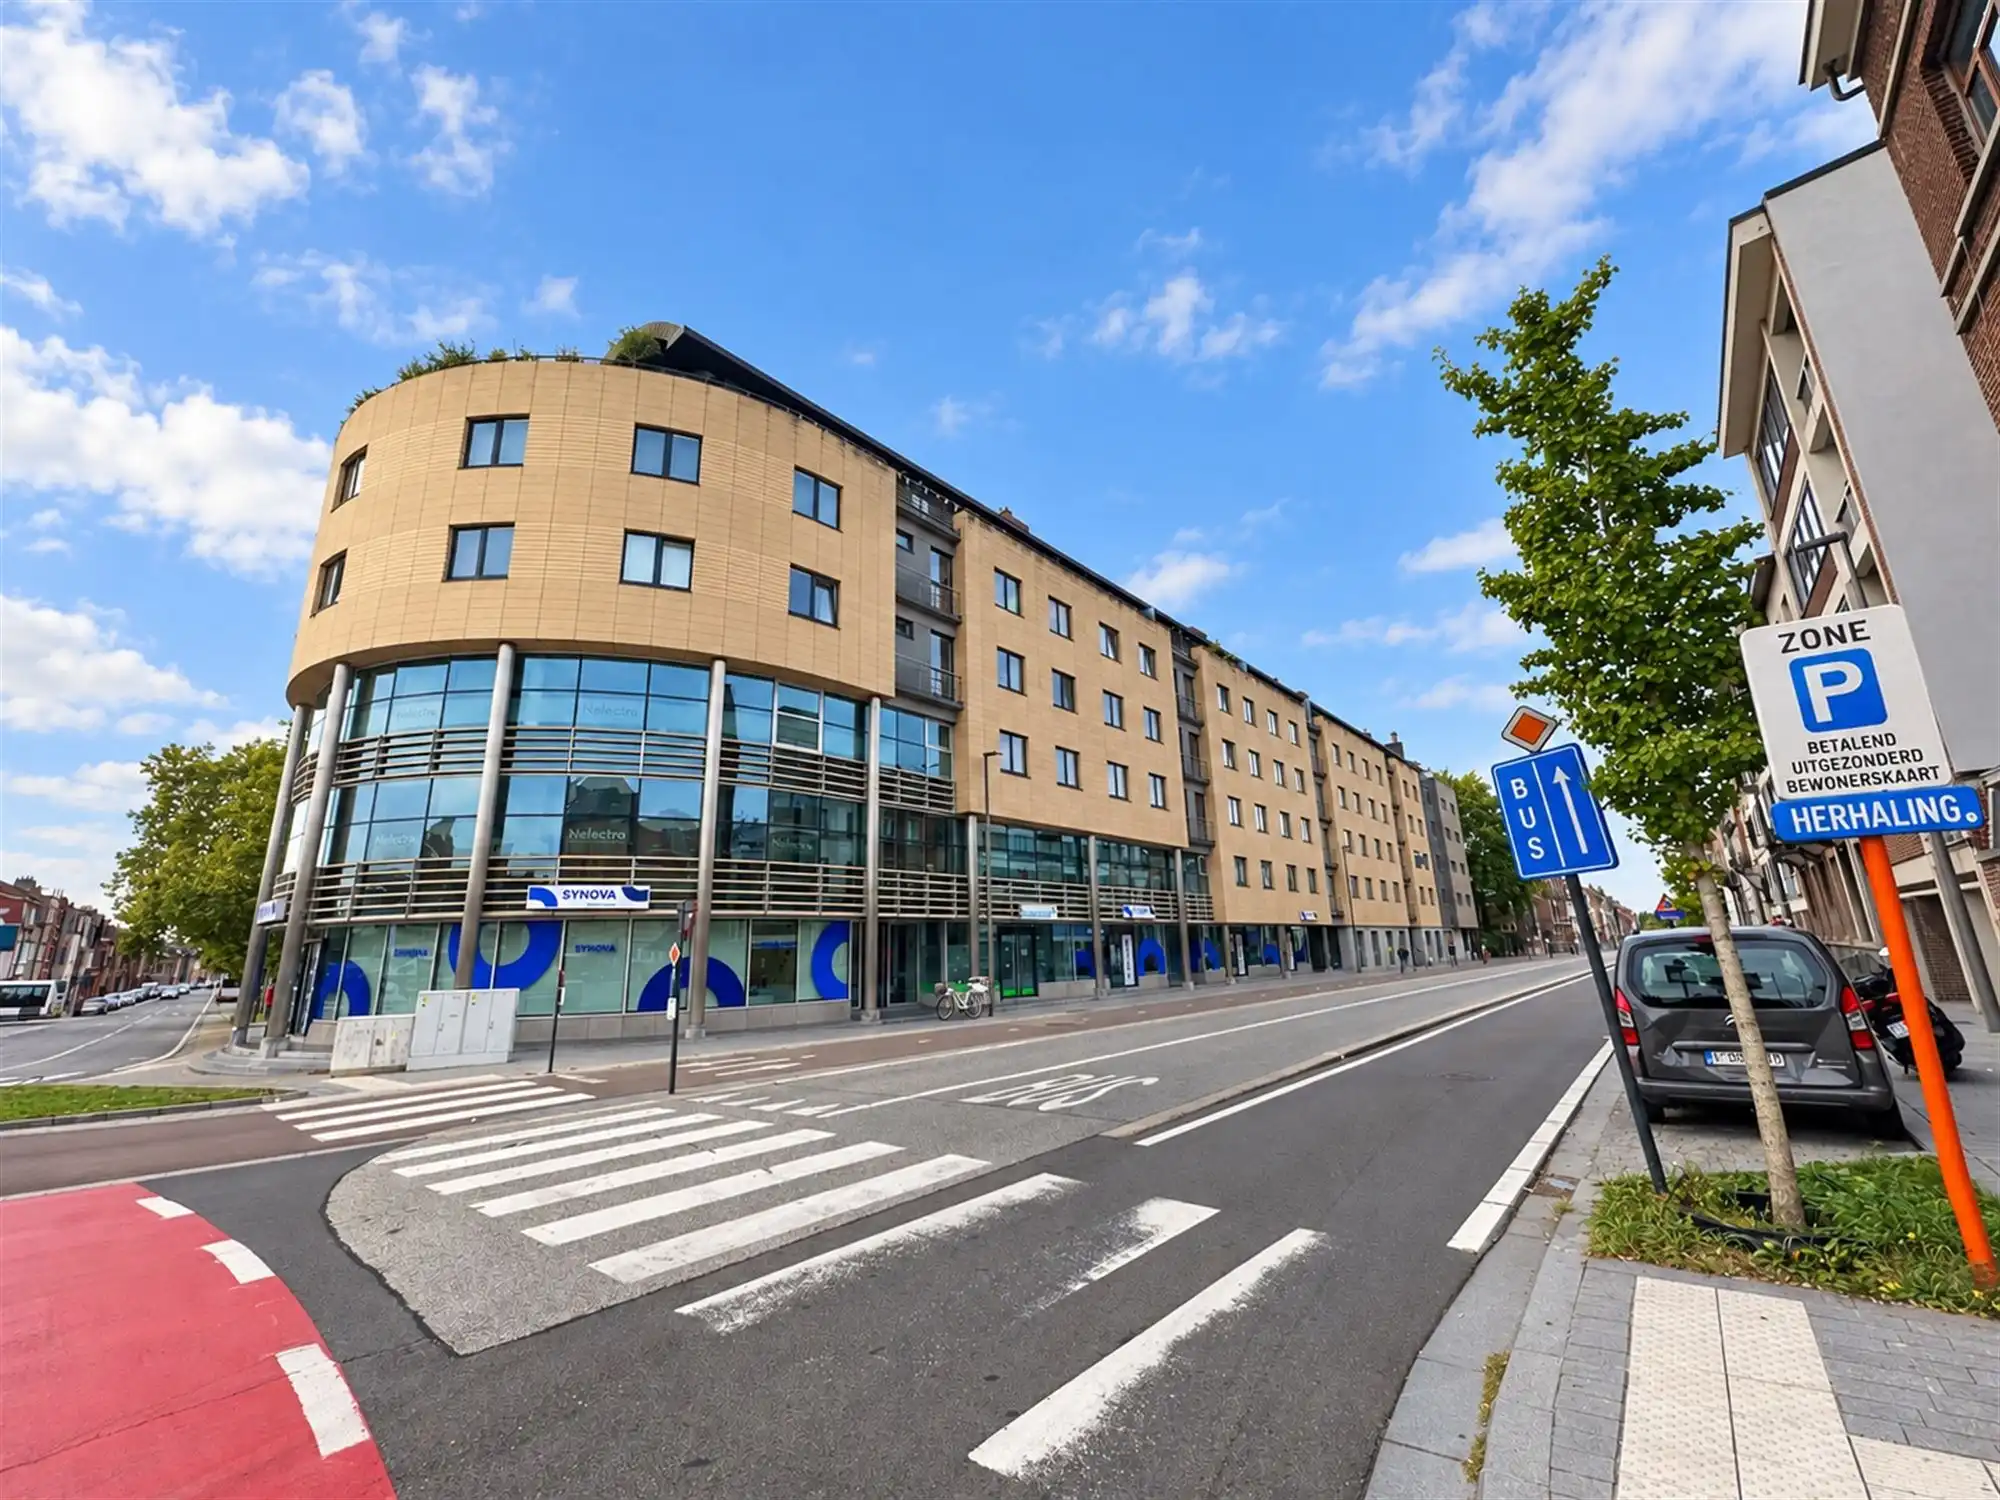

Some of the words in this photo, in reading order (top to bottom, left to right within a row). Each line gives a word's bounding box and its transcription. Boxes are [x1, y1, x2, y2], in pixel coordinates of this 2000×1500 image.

[1778, 619, 1871, 654] ZONE
[1802, 661, 1864, 723] P
[1807, 732, 1897, 755] BETALEND
[1791, 748, 1924, 775] UITGEZONDERD
[1786, 765, 1940, 794] BEWONERSKAART
[1510, 777, 1545, 860] BUS
[562, 889, 617, 900] SYNOVA
